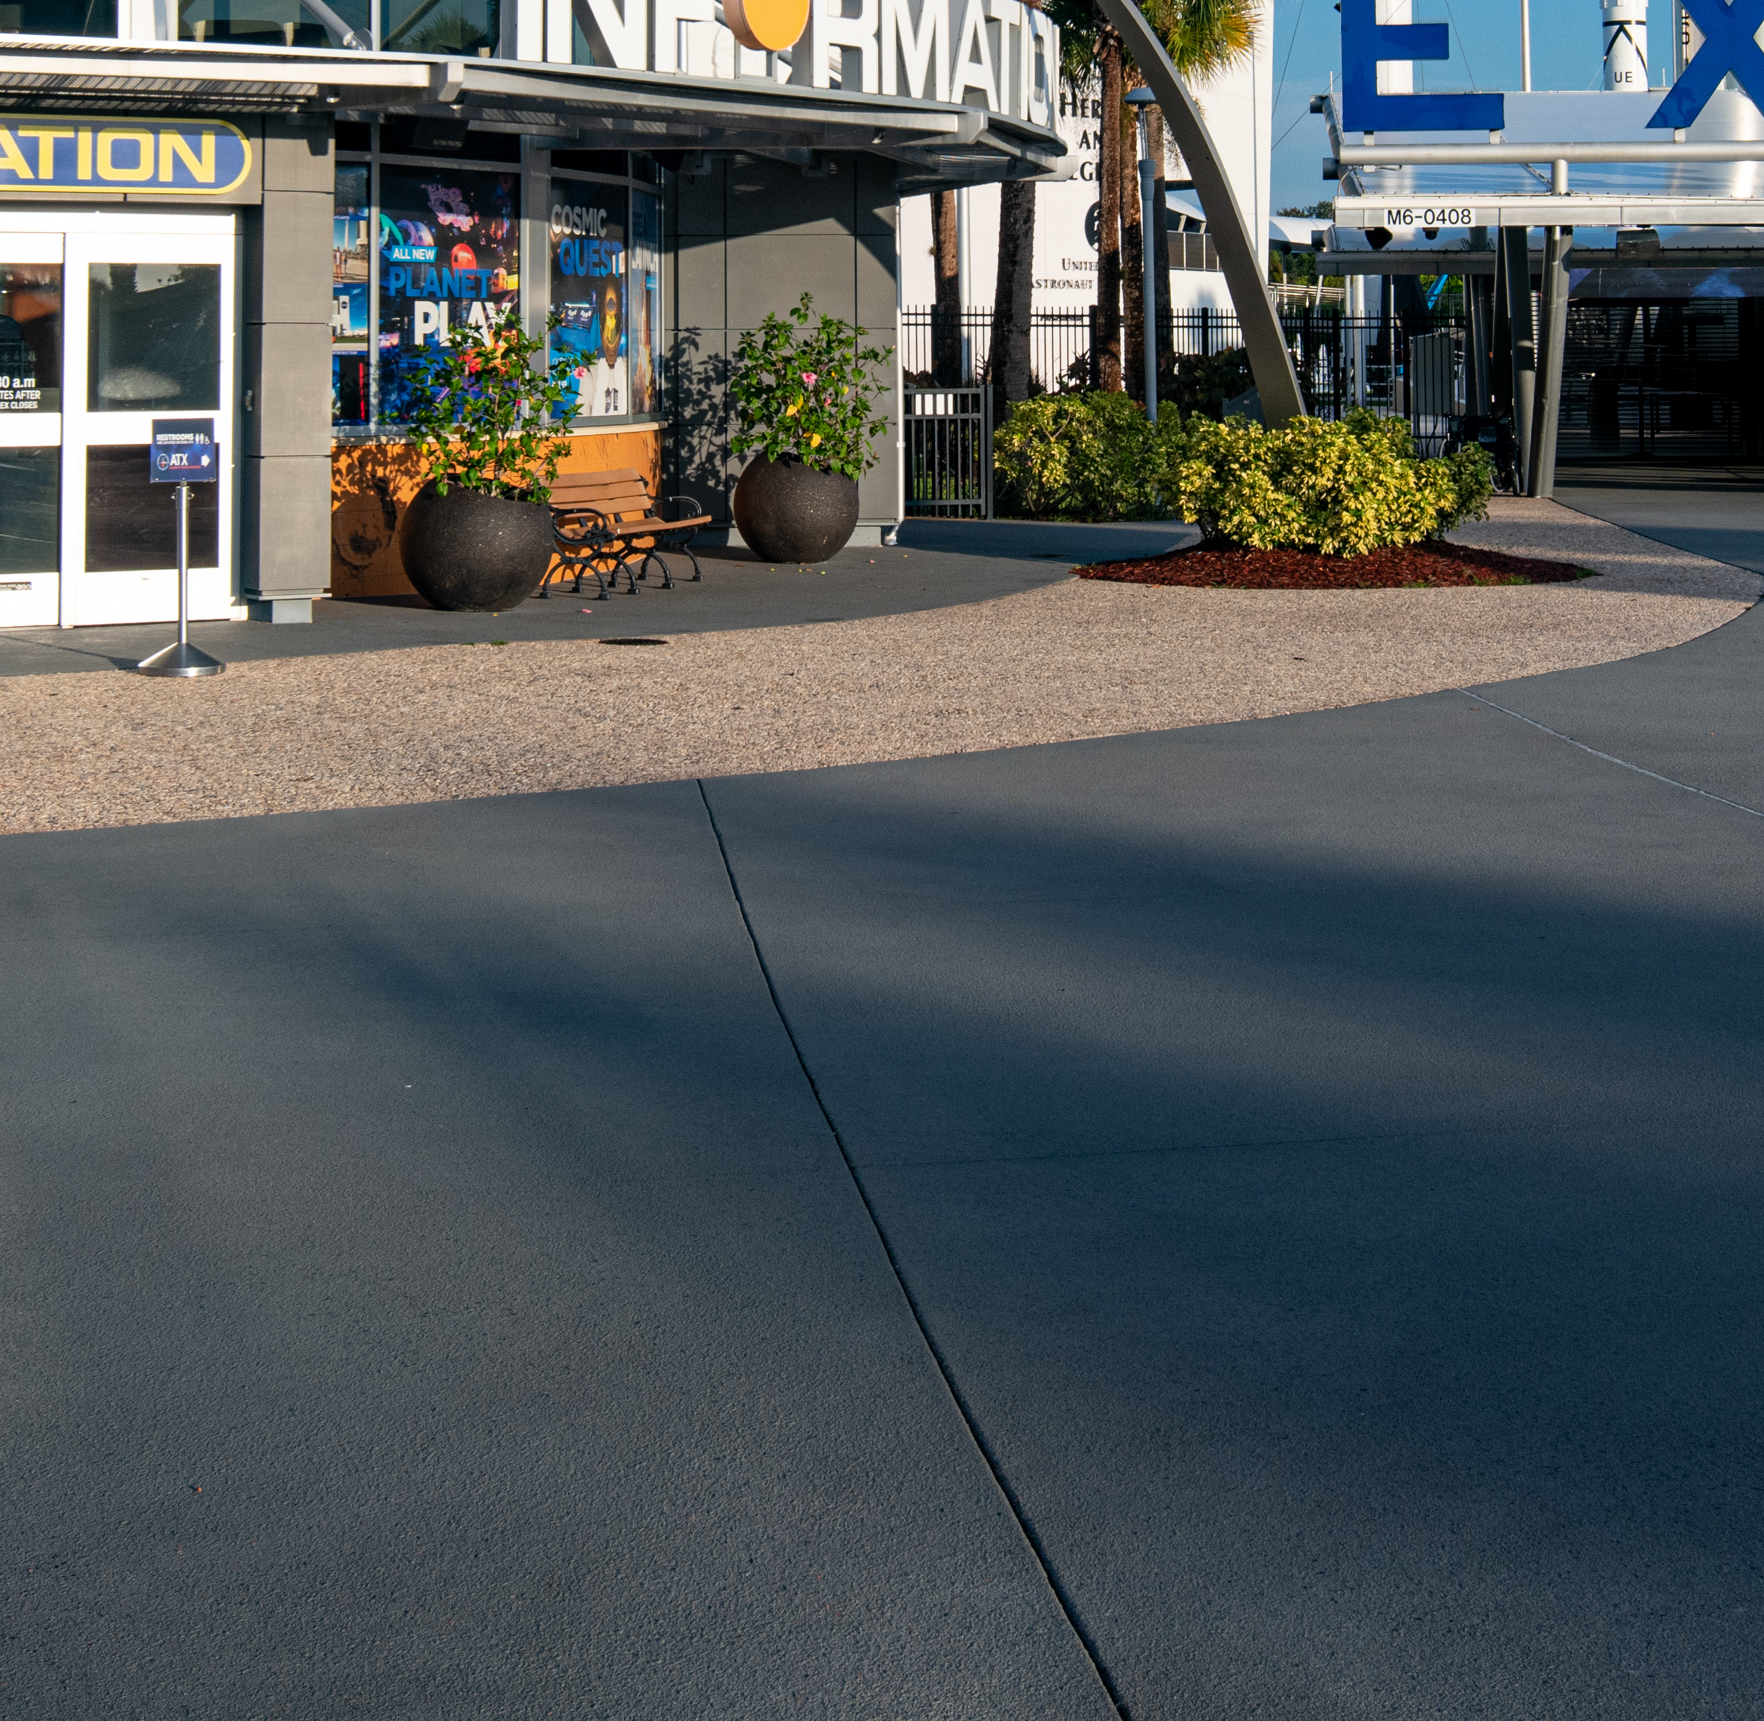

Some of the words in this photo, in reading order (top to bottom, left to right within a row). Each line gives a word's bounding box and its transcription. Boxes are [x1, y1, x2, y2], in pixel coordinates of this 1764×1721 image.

[1614, 71, 1633, 84] UE
[551, 204, 607, 238] COSMIC
[1387, 208, 1472, 226] M6-0408
[392, 247, 412, 260] ALL
[412, 247, 435, 261] NEW
[559, 237, 624, 278] QUEST
[389, 266, 492, 298] PLANET
[1032, 279, 1094, 289] STRONAUT
[413, 300, 512, 347] PLAY
[12, 377, 35, 388] a.m
[14, 389, 41, 400] AFTER
[10, 401, 39, 409] CLOSES
[156, 433, 194, 441] RESTROOMS
[169, 453, 189, 466] ATX
